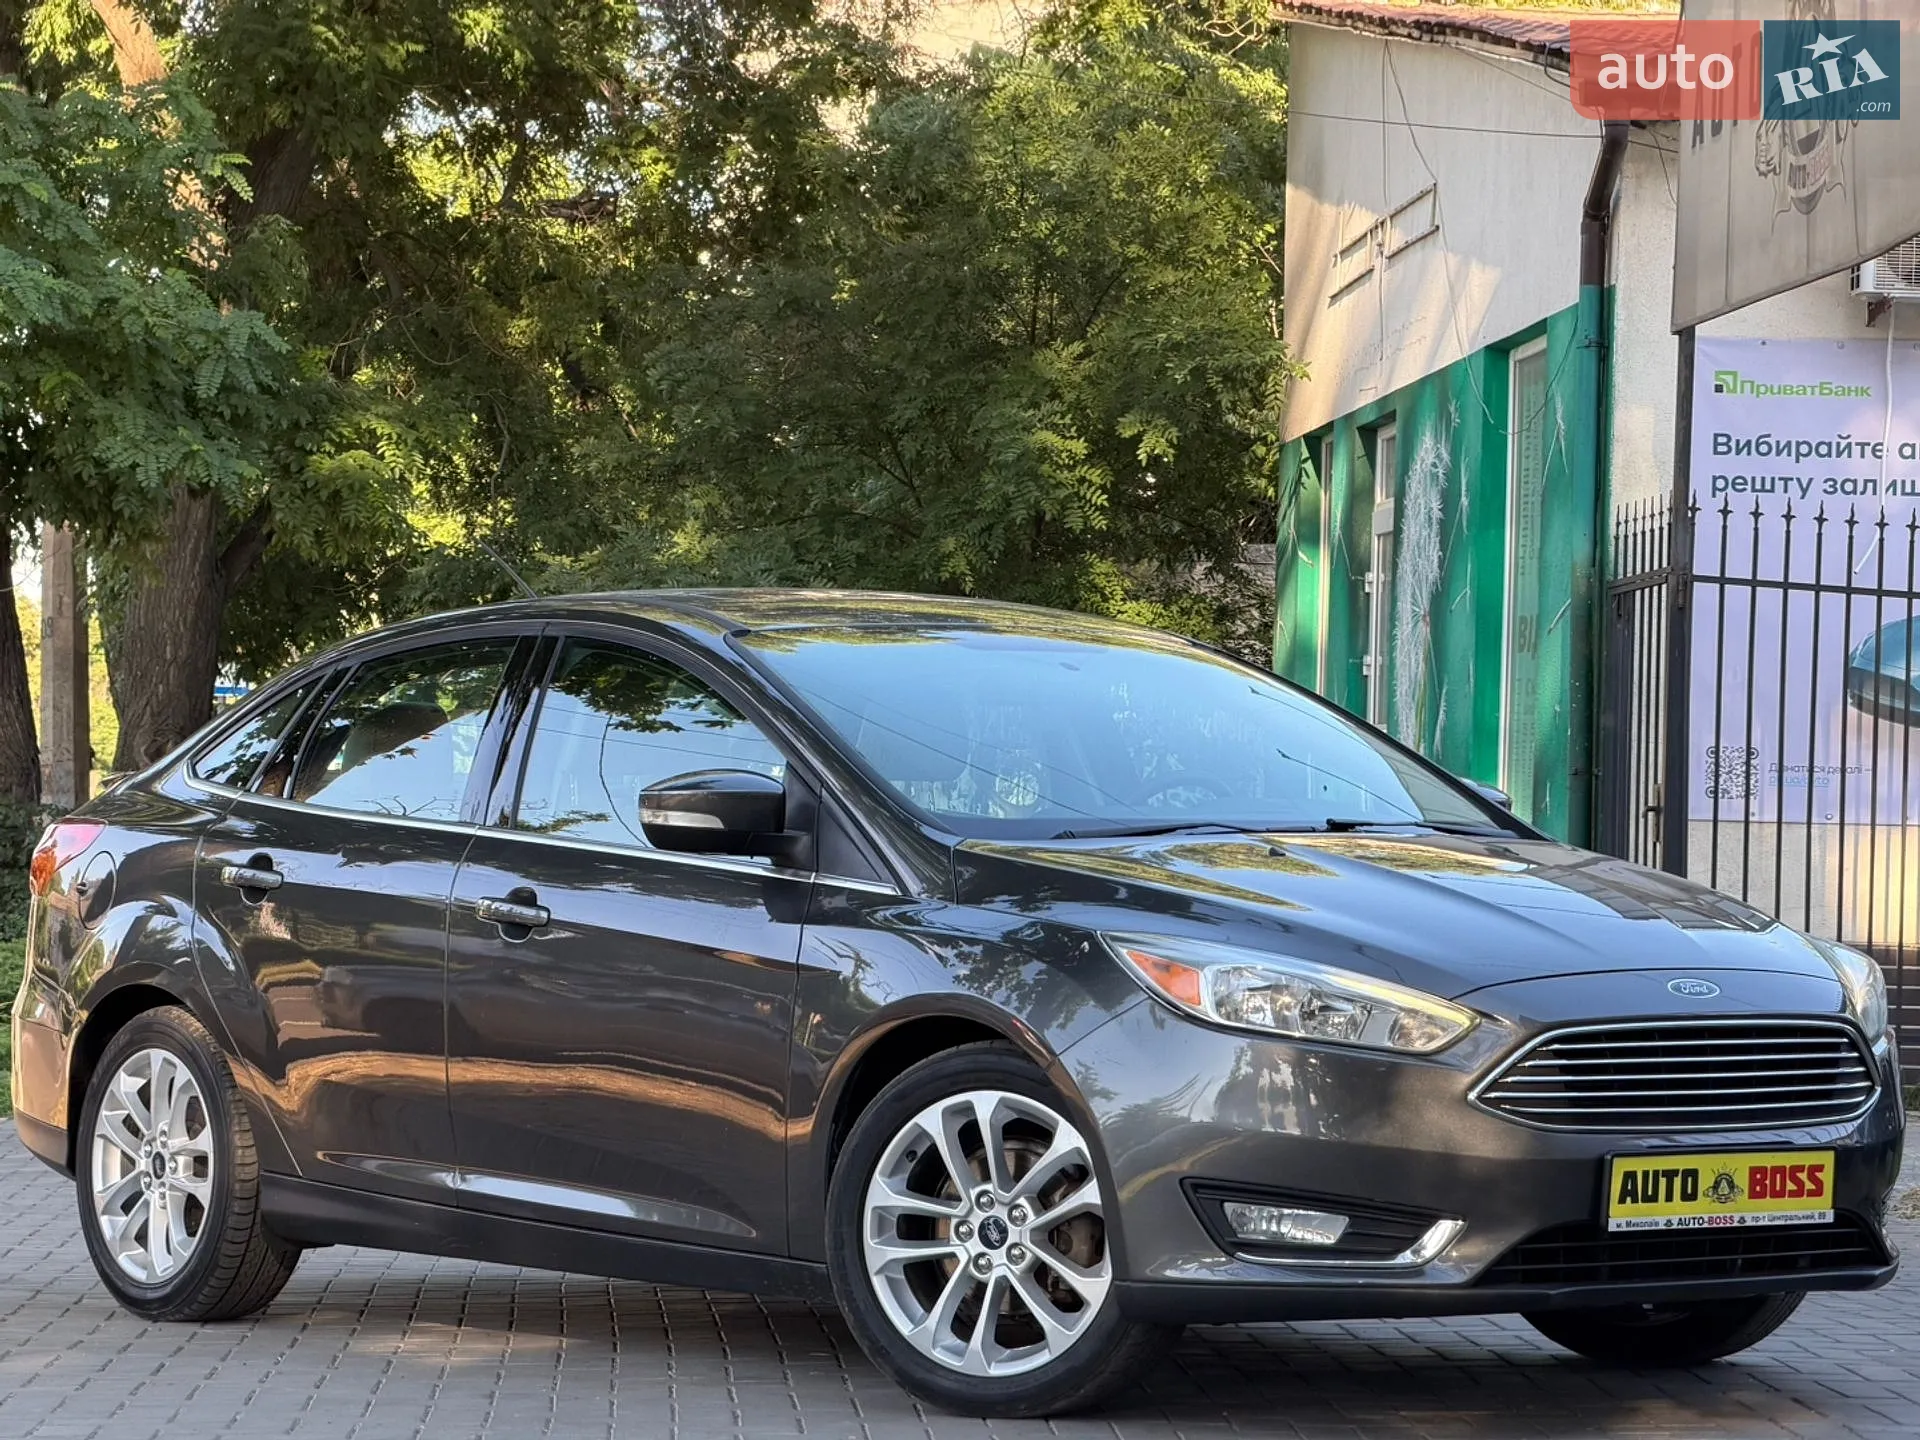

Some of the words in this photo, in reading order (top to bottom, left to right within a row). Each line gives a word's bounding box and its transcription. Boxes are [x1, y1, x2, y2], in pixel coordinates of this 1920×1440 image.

[1739, 379, 1872, 398] ПриватБанк
[1712, 432, 1889, 463] Вибирайте
[1898, 442, 1920, 460] а
[1711, 474, 1814, 499] решту
[1617, 1168, 1699, 1205] AUTO
[1748, 1164, 1825, 1200] BOSS
[1676, 1214, 1735, 1228] AUTO-BOSS
